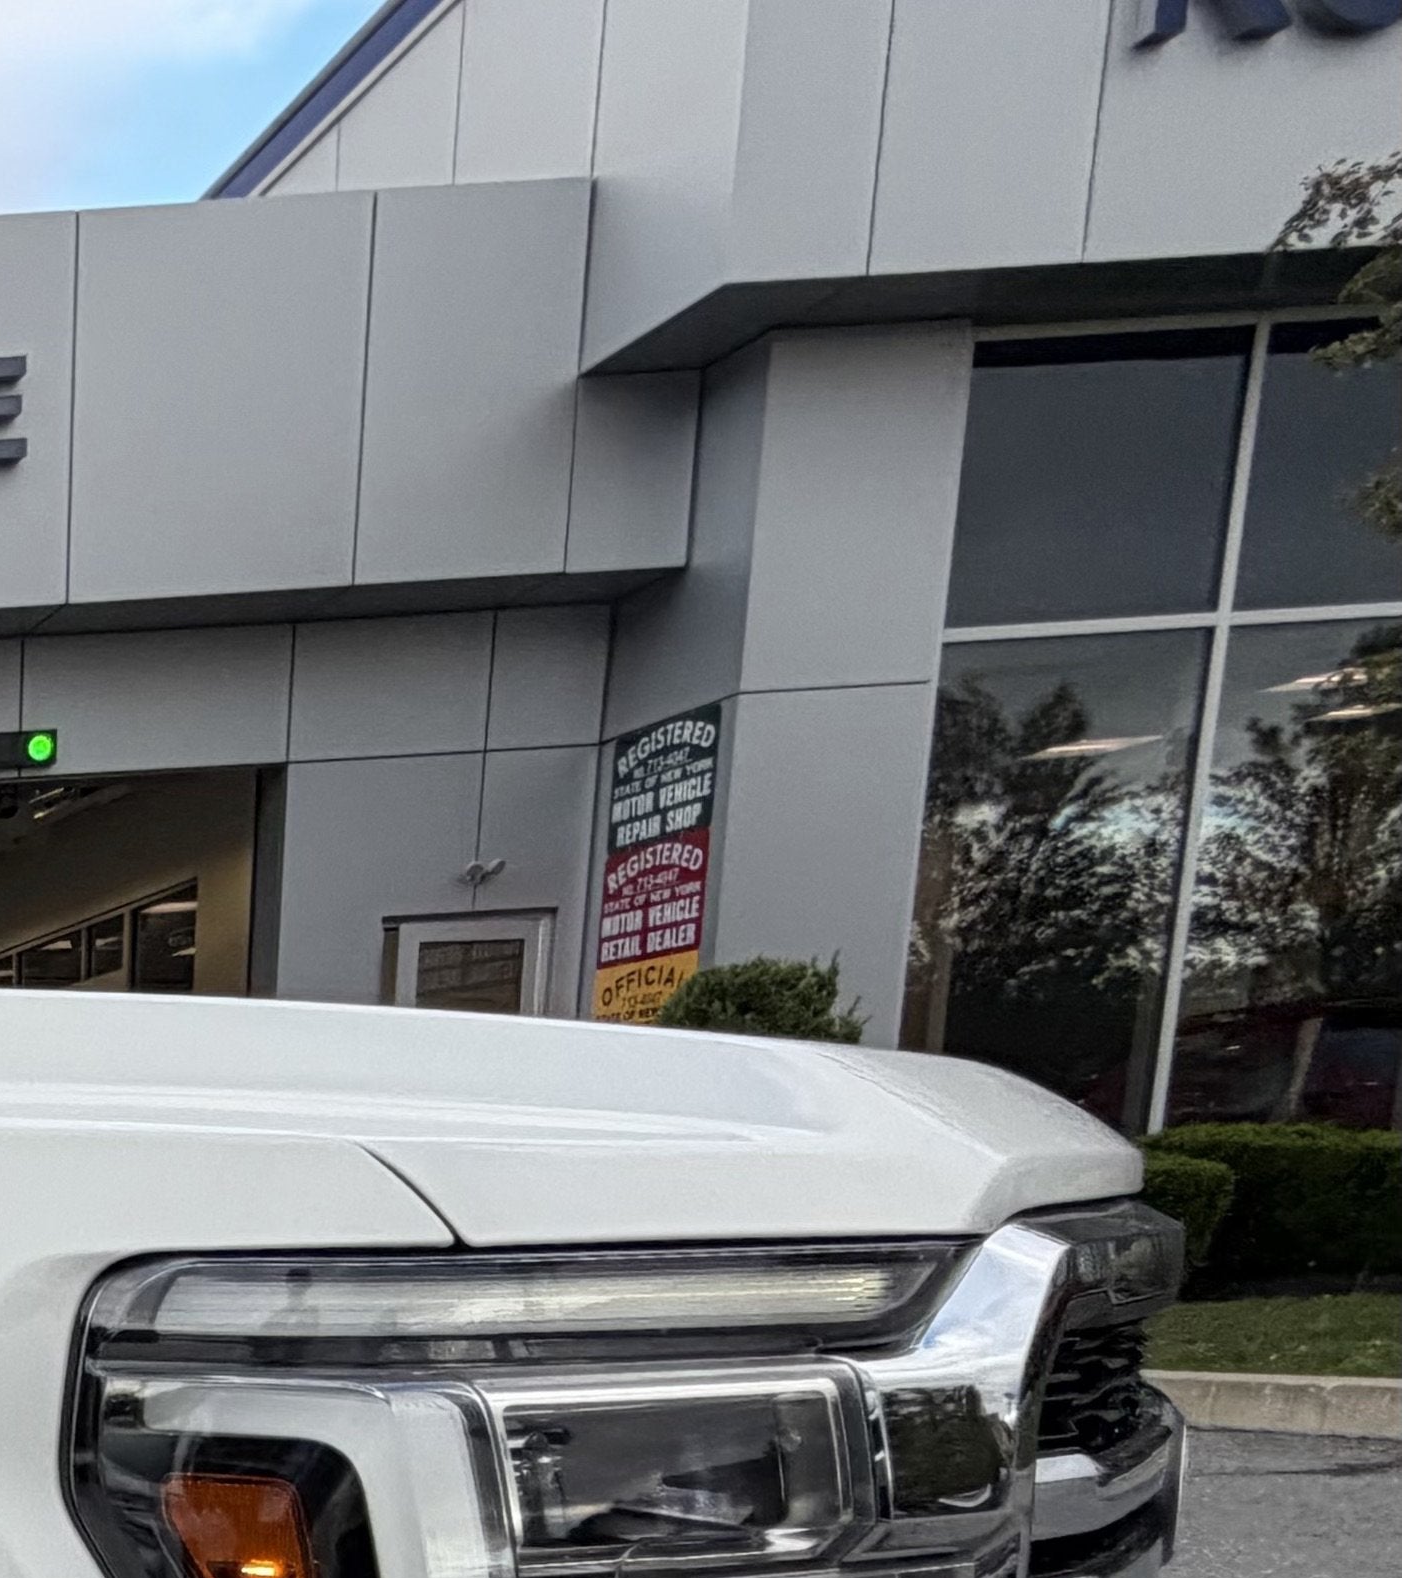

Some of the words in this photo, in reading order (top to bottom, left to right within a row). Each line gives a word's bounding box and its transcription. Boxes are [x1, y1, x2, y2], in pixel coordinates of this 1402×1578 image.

[617, 720, 715, 779] REGISTERED
[611, 791, 654, 823] MOTOR
[659, 772, 712, 809] VEHICLE
[614, 780, 642, 800] STATE
[644, 775, 658, 789] OF
[660, 767, 683, 783] NEW
[685, 757, 714, 775] YORK
[616, 814, 661, 847] REPAIR
[665, 802, 702, 834] SHOP
[607, 842, 703, 895] REGISTERED
[601, 909, 643, 939] MOTOR
[648, 895, 700, 927] VEHICLE
[604, 898, 631, 914] STATE
[633, 894, 647, 907] OF
[650, 888, 671, 903] NEW
[675, 880, 702, 896] YORK
[601, 935, 642, 963] RETAIL
[647, 923, 696, 953] DEALER
